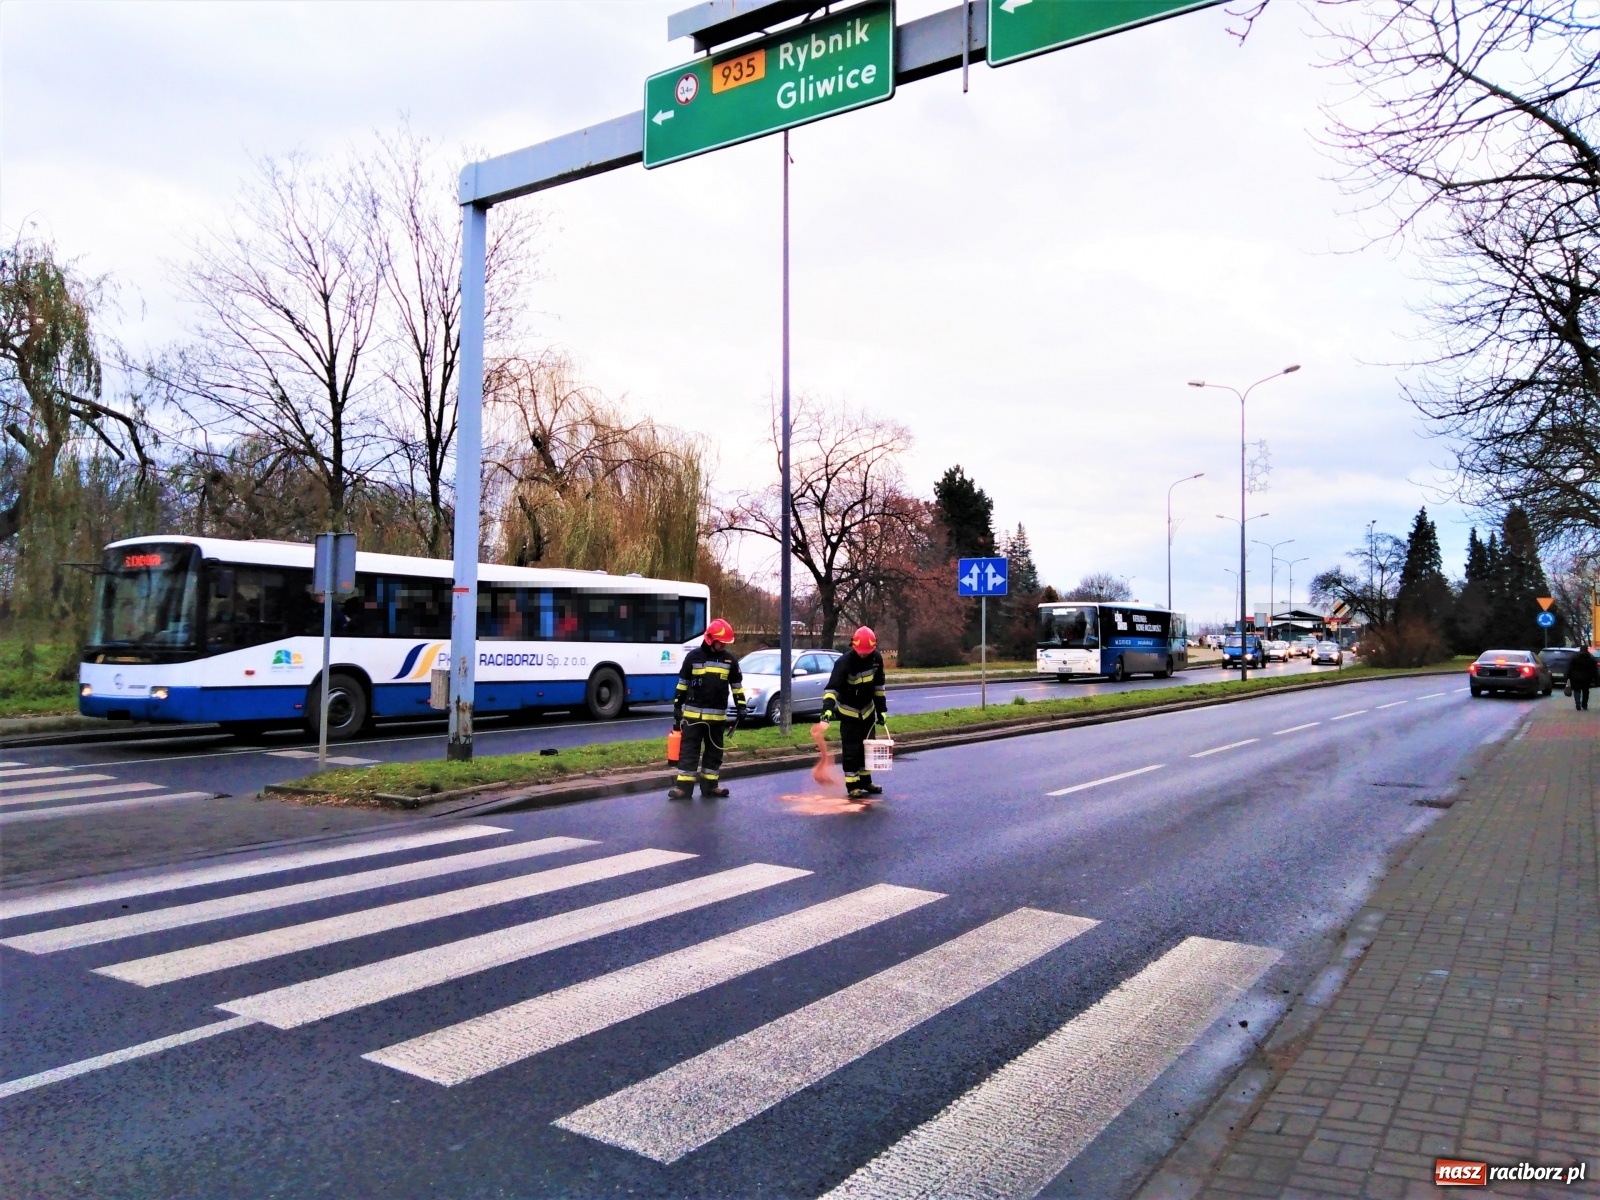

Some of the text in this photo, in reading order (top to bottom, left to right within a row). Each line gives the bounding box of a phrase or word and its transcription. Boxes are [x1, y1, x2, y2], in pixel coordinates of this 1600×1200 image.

[779, 18, 870, 72] Rybnik
[721, 56, 756, 86] 935
[776, 64, 877, 109] Gliwice
[479, 653, 544, 666] RACIBORZU
[546, 653, 562, 669] Sp.
[563, 656, 569, 666] z
[571, 656, 589, 666] o.o.
